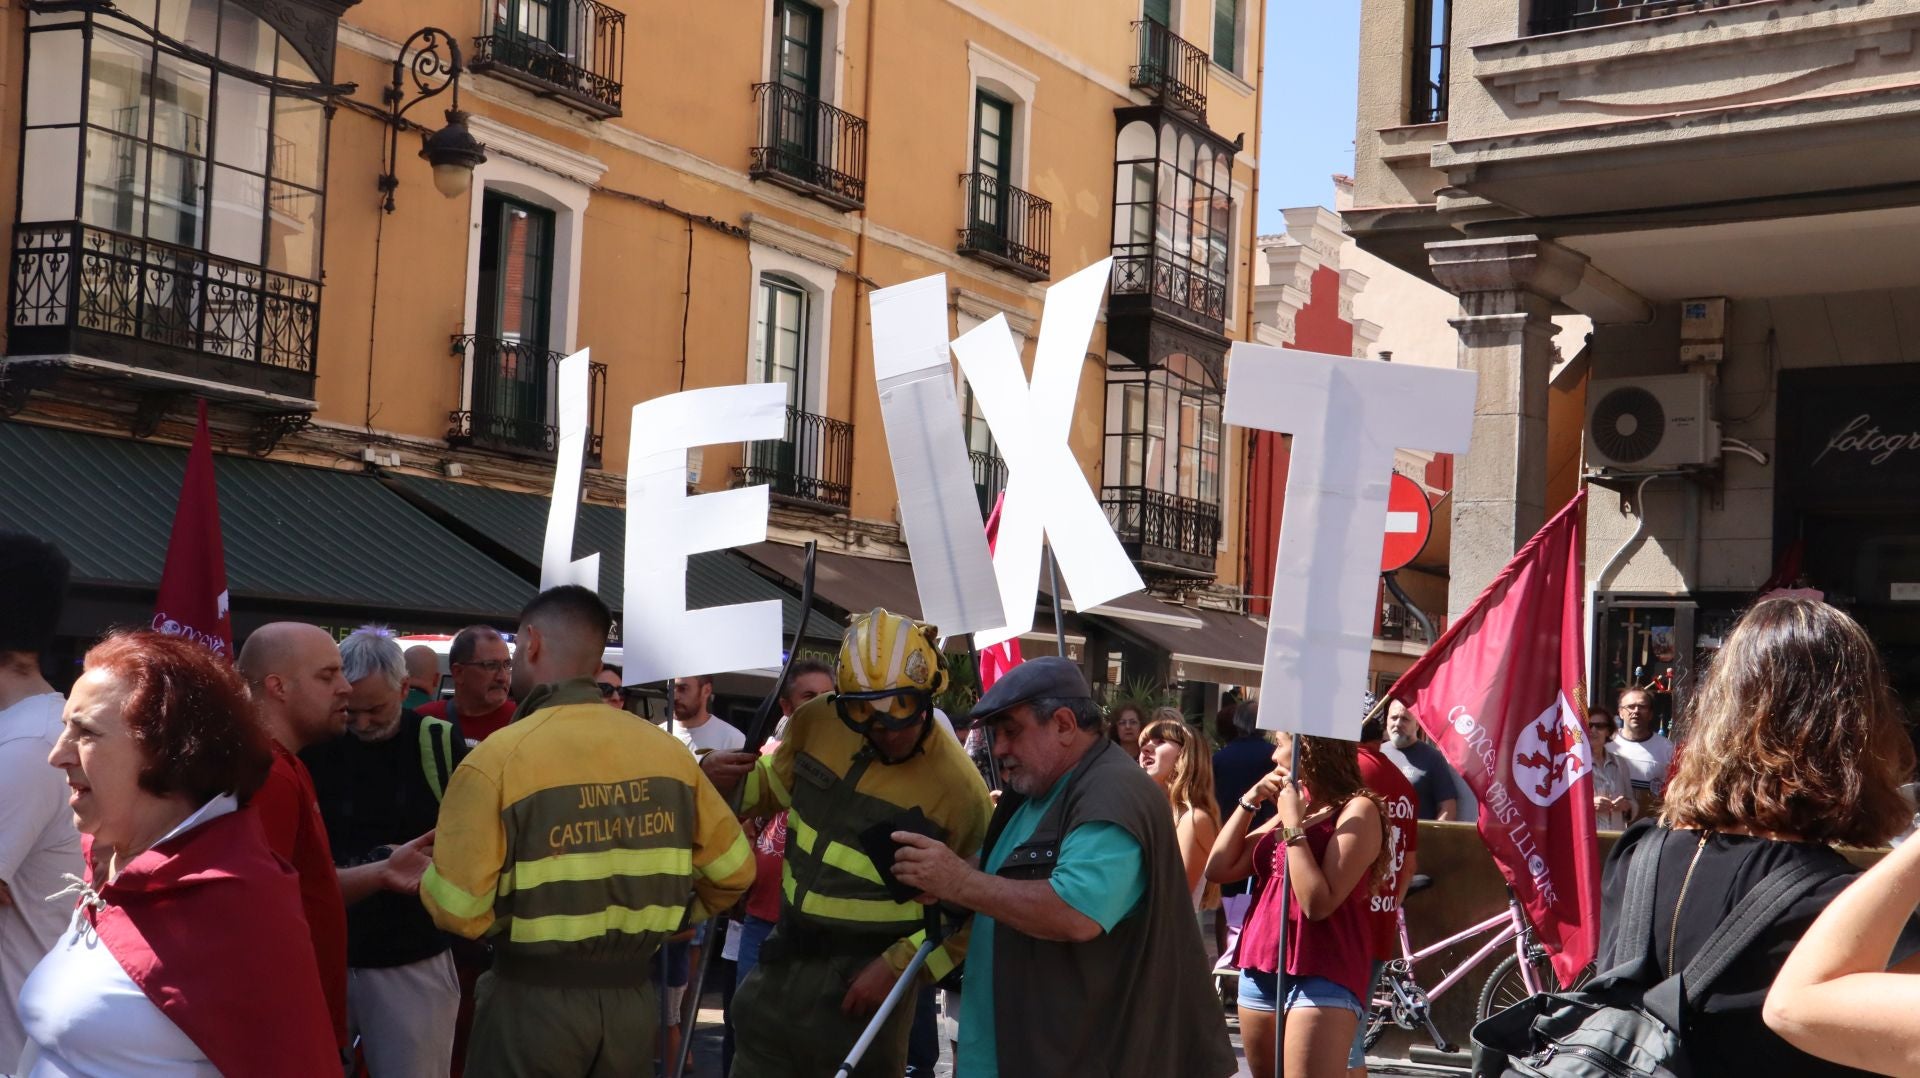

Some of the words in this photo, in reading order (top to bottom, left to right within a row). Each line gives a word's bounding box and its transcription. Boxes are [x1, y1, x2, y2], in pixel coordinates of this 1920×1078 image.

[578, 784, 627, 809] JUNTA
[629, 779, 650, 803] DE
[549, 817, 622, 848] CASTILLA
[625, 816, 636, 838] Y
[639, 806, 675, 837] LEÓN
